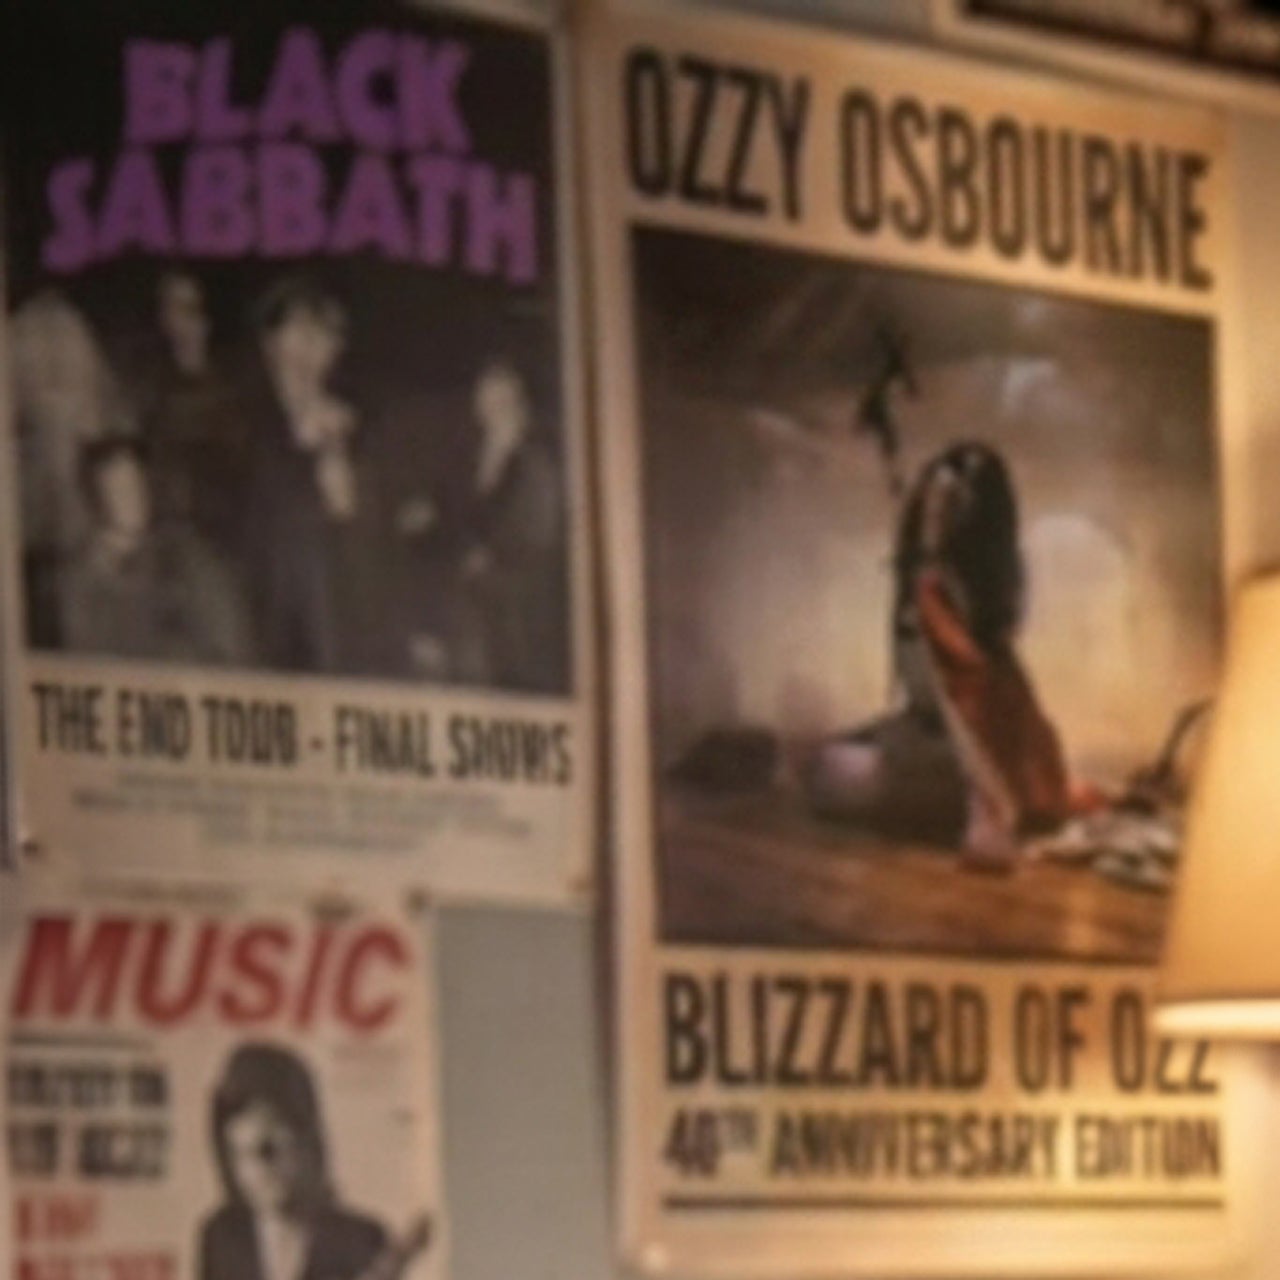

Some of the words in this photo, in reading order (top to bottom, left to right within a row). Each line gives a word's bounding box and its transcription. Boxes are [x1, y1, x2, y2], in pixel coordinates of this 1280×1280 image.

[123, 24, 470, 153] BLACK
[41, 143, 539, 286] SABBATH
[624, 46, 811, 222] OZZY
[839, 88, 1213, 293] OSBOURNE
[30, 681, 107, 757] THE
[116, 688, 192, 764] END
[333, 705, 434, 778] FINAL
[8, 915, 411, 1037] MUSIC
[661, 972, 990, 1091] BLIZZARD
[1012, 984, 1088, 1094] OF
[769, 1110, 1059, 1180] ANNIVERSARY
[1075, 1114, 1221, 1180] EDITION
